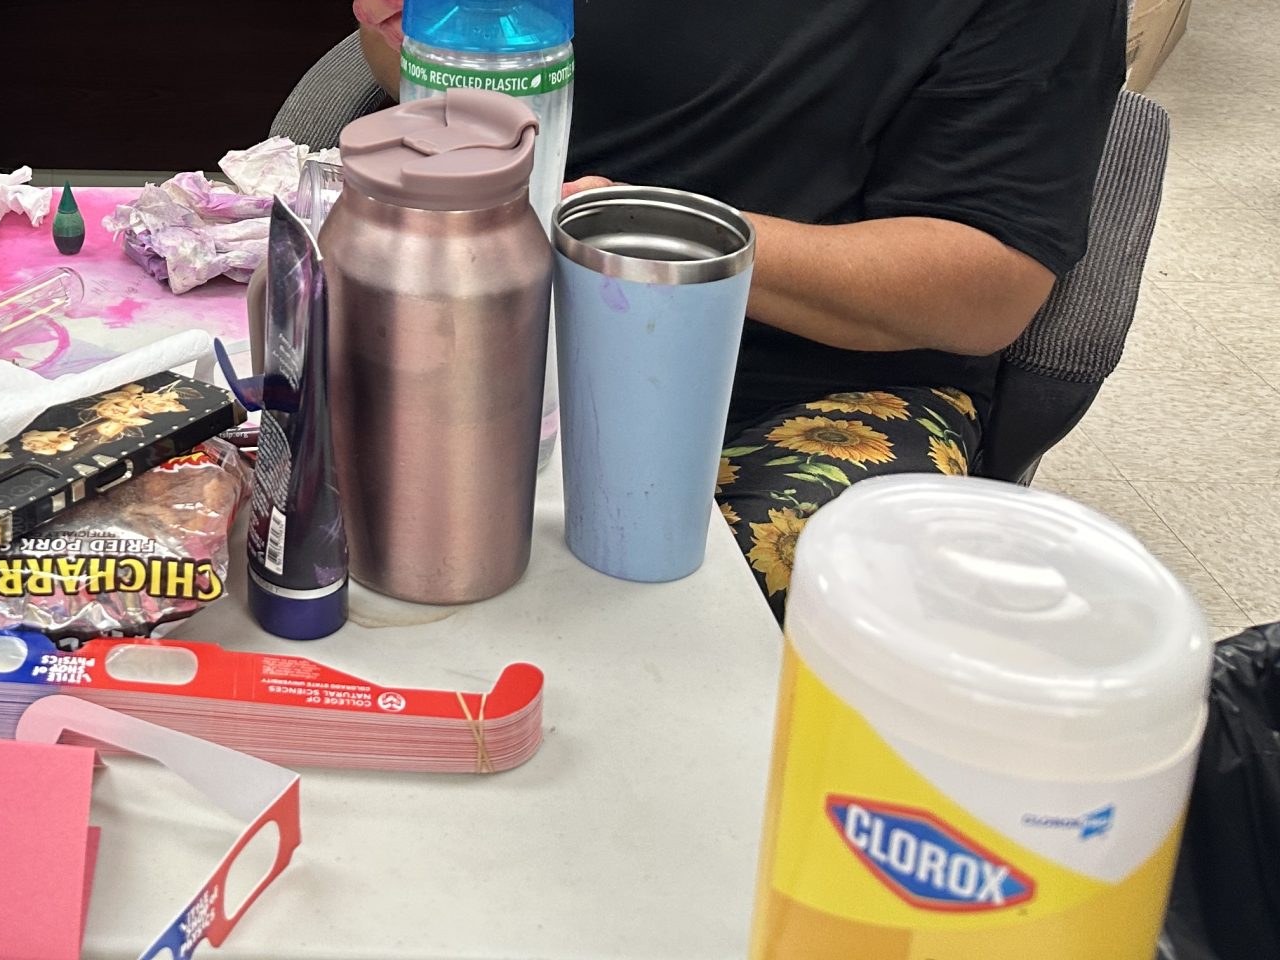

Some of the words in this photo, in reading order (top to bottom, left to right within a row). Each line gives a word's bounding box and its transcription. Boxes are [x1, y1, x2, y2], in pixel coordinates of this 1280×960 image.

[408, 62, 428, 81] 100%
[429, 71, 483, 90] RECYCLED
[484, 77, 528, 92] PLASTIC
[20, 537, 81, 553] PORK
[89, 538, 155, 553] FRIED
[261, 677, 304, 686] UNIVERSITY
[330, 683, 371, 691] COLORADO
[268, 685, 320, 696] SCIENCES
[323, 689, 371, 698] NATURAL
[324, 696, 372, 707] COLLEGE
[842, 802, 1010, 907] CLOROX
